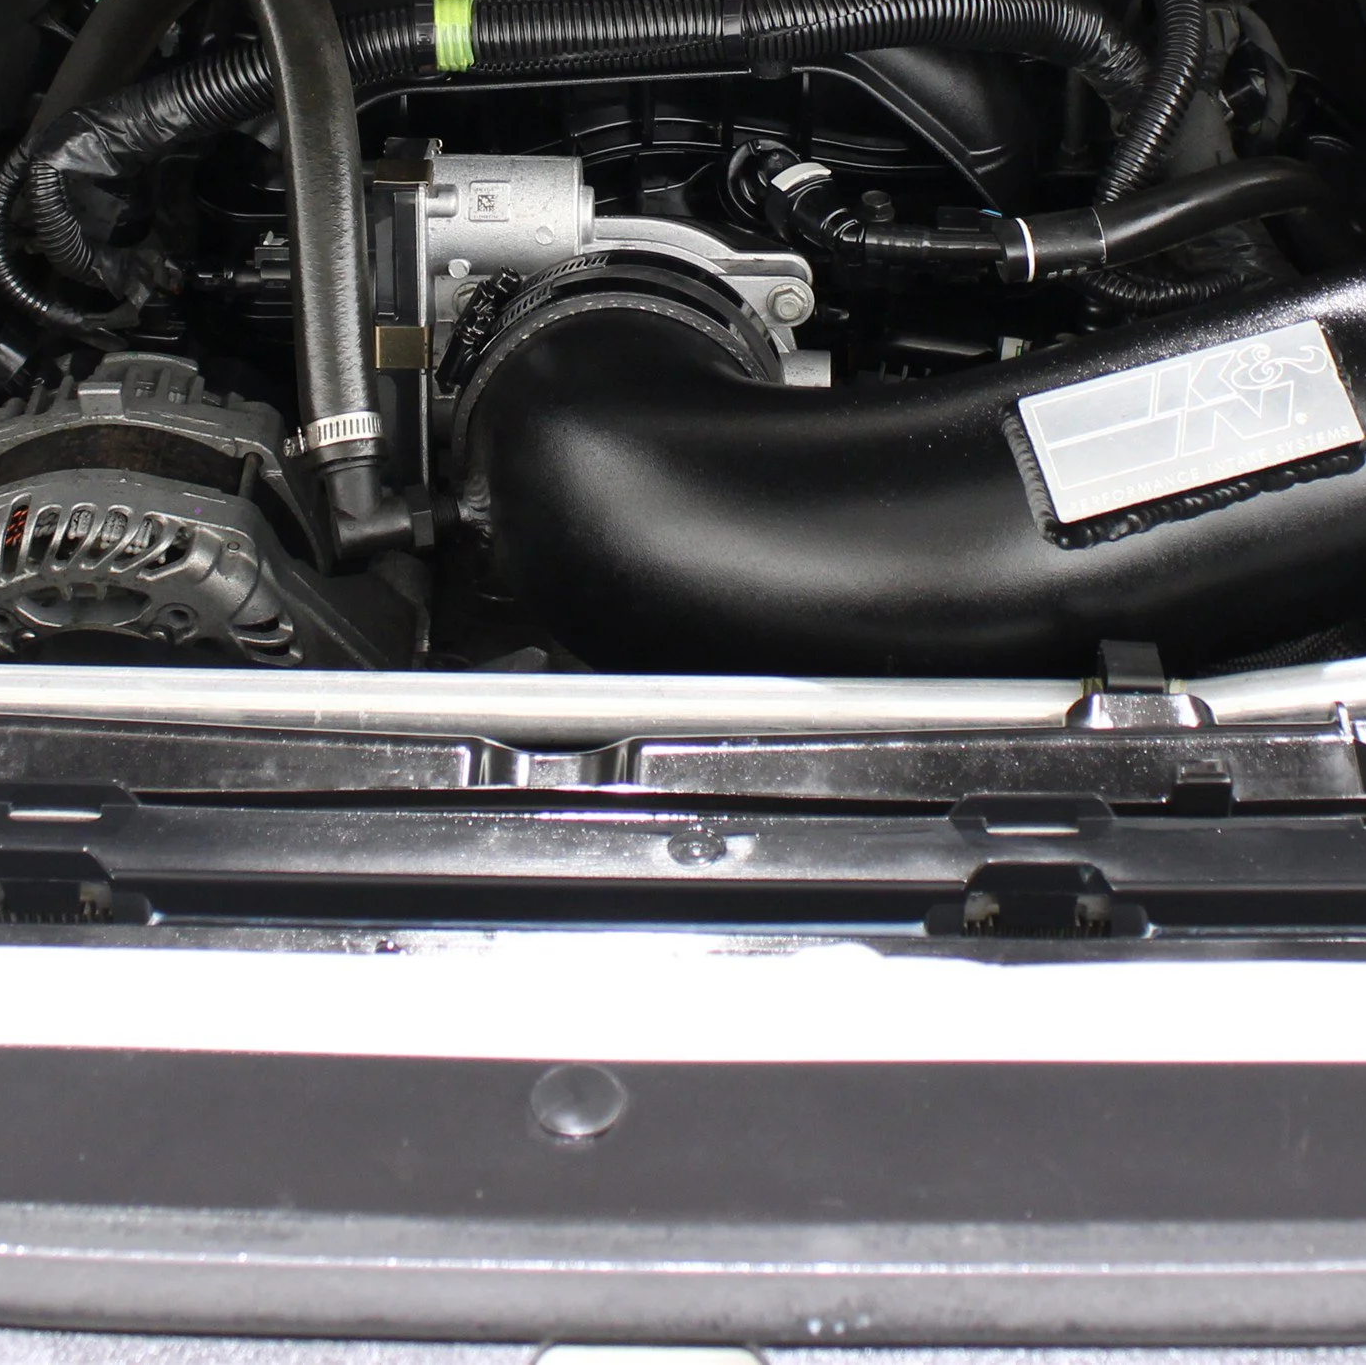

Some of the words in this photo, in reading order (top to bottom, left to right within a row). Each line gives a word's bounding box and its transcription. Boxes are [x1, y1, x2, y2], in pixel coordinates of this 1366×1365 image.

[1068, 467, 1201, 512] PERFORMANCE
[1206, 447, 1268, 478] INTAKE
[1276, 425, 1351, 456] SYSTEMS
